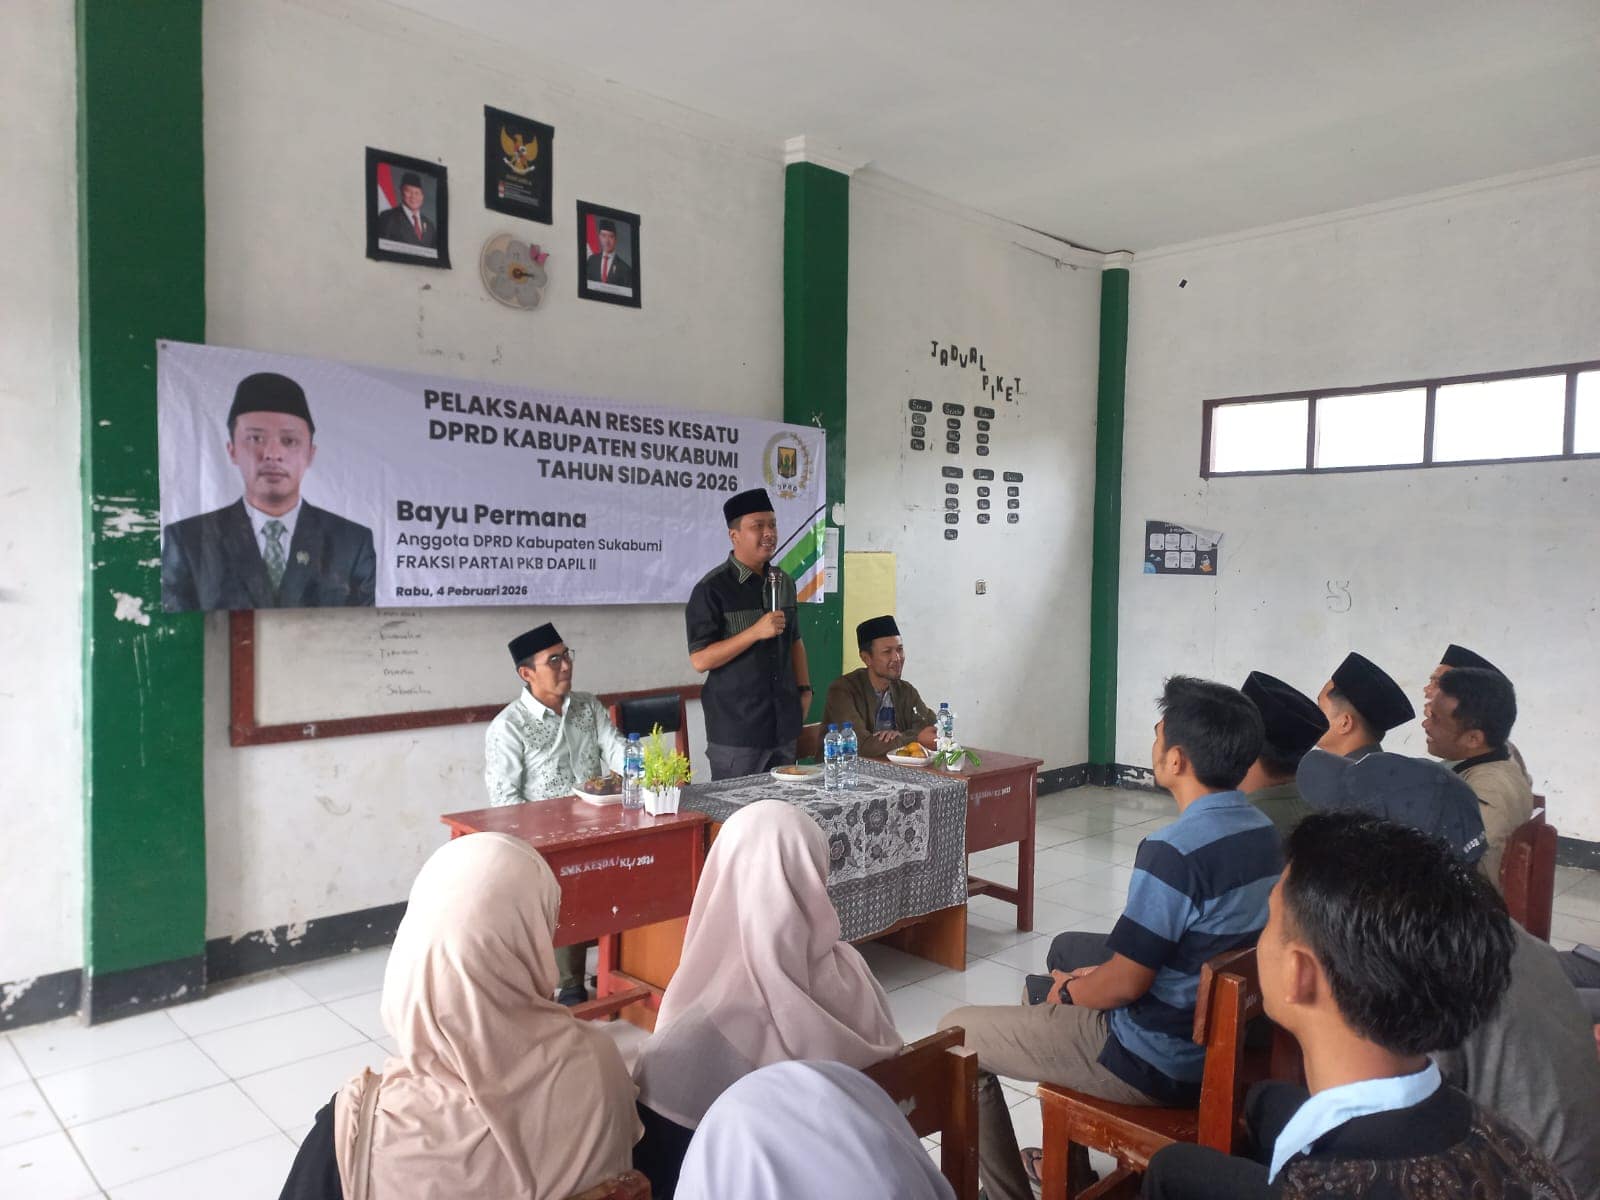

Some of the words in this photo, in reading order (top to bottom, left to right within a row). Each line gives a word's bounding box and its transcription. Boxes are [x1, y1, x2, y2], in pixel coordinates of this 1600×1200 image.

[982, 374, 1021, 402] PIKET
[423, 388, 601, 430] PELAKSANAAN
[605, 411, 665, 437] RESES
[668, 420, 739, 444] KESATU
[429, 419, 498, 445] DPRD
[503, 426, 636, 459] KABUPATEN
[640, 441, 739, 469] SUKABUMI
[537, 458, 614, 482] TAHUN
[618, 465, 693, 489] SIDANG
[696, 471, 738, 492] 2026
[396, 499, 468, 530] Bayu
[474, 503, 587, 529] Permana
[396, 532, 469, 551] Anggota
[473, 534, 513, 548] DPRD
[516, 535, 595, 553] Kabupaten
[598, 538, 662, 552] Sukabumi
[396, 555, 455, 569] FRAKSI
[459, 556, 513, 569] PARTAI
[517, 556, 543, 570] PKB
[547, 557, 586, 570] DAPIL
[589, 558, 597, 571] II
[395, 586, 433, 598] Rabu,
[436, 586, 445, 596] 4
[447, 585, 500, 596] Pebruari
[501, 585, 528, 596] 2026
